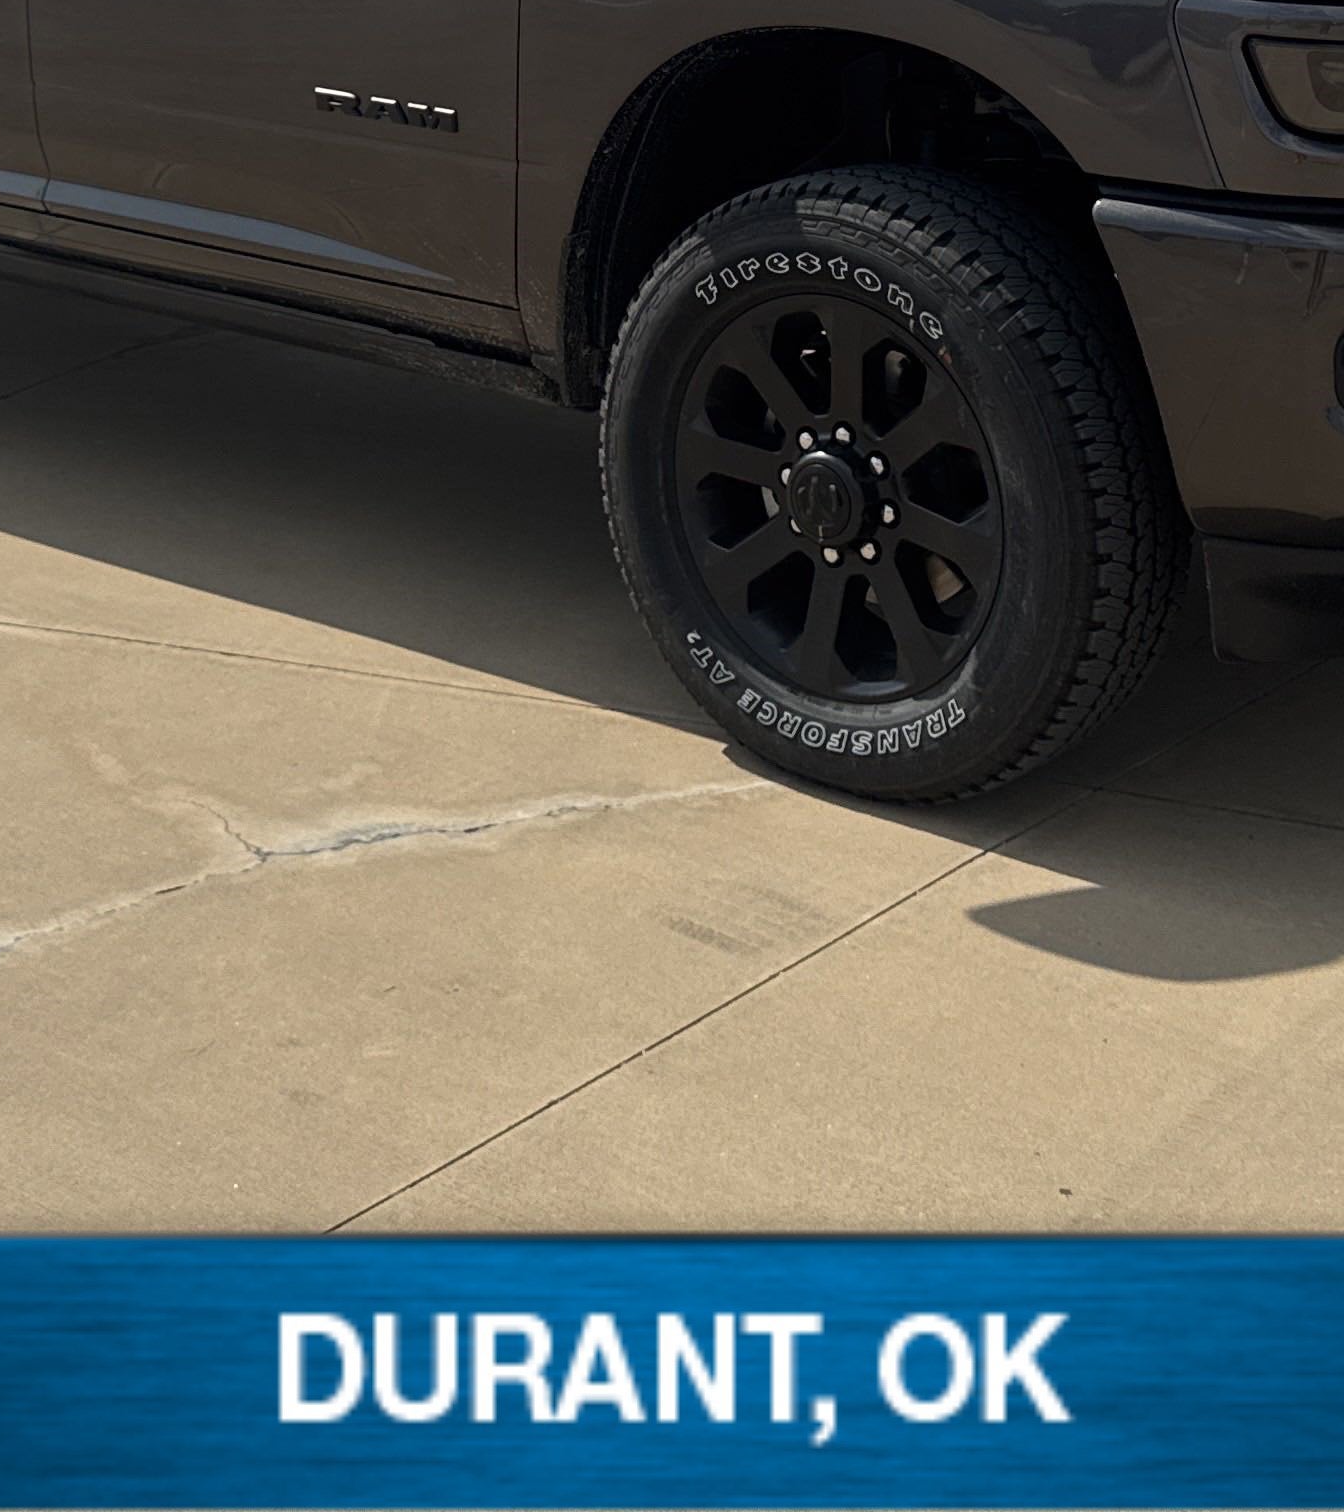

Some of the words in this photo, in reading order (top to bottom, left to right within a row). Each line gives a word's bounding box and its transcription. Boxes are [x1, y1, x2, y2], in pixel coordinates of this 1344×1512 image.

[314, 87, 459, 133] RAM
[695, 252, 943, 339] Firestone
[737, 688, 965, 755] TRANSFORCE
